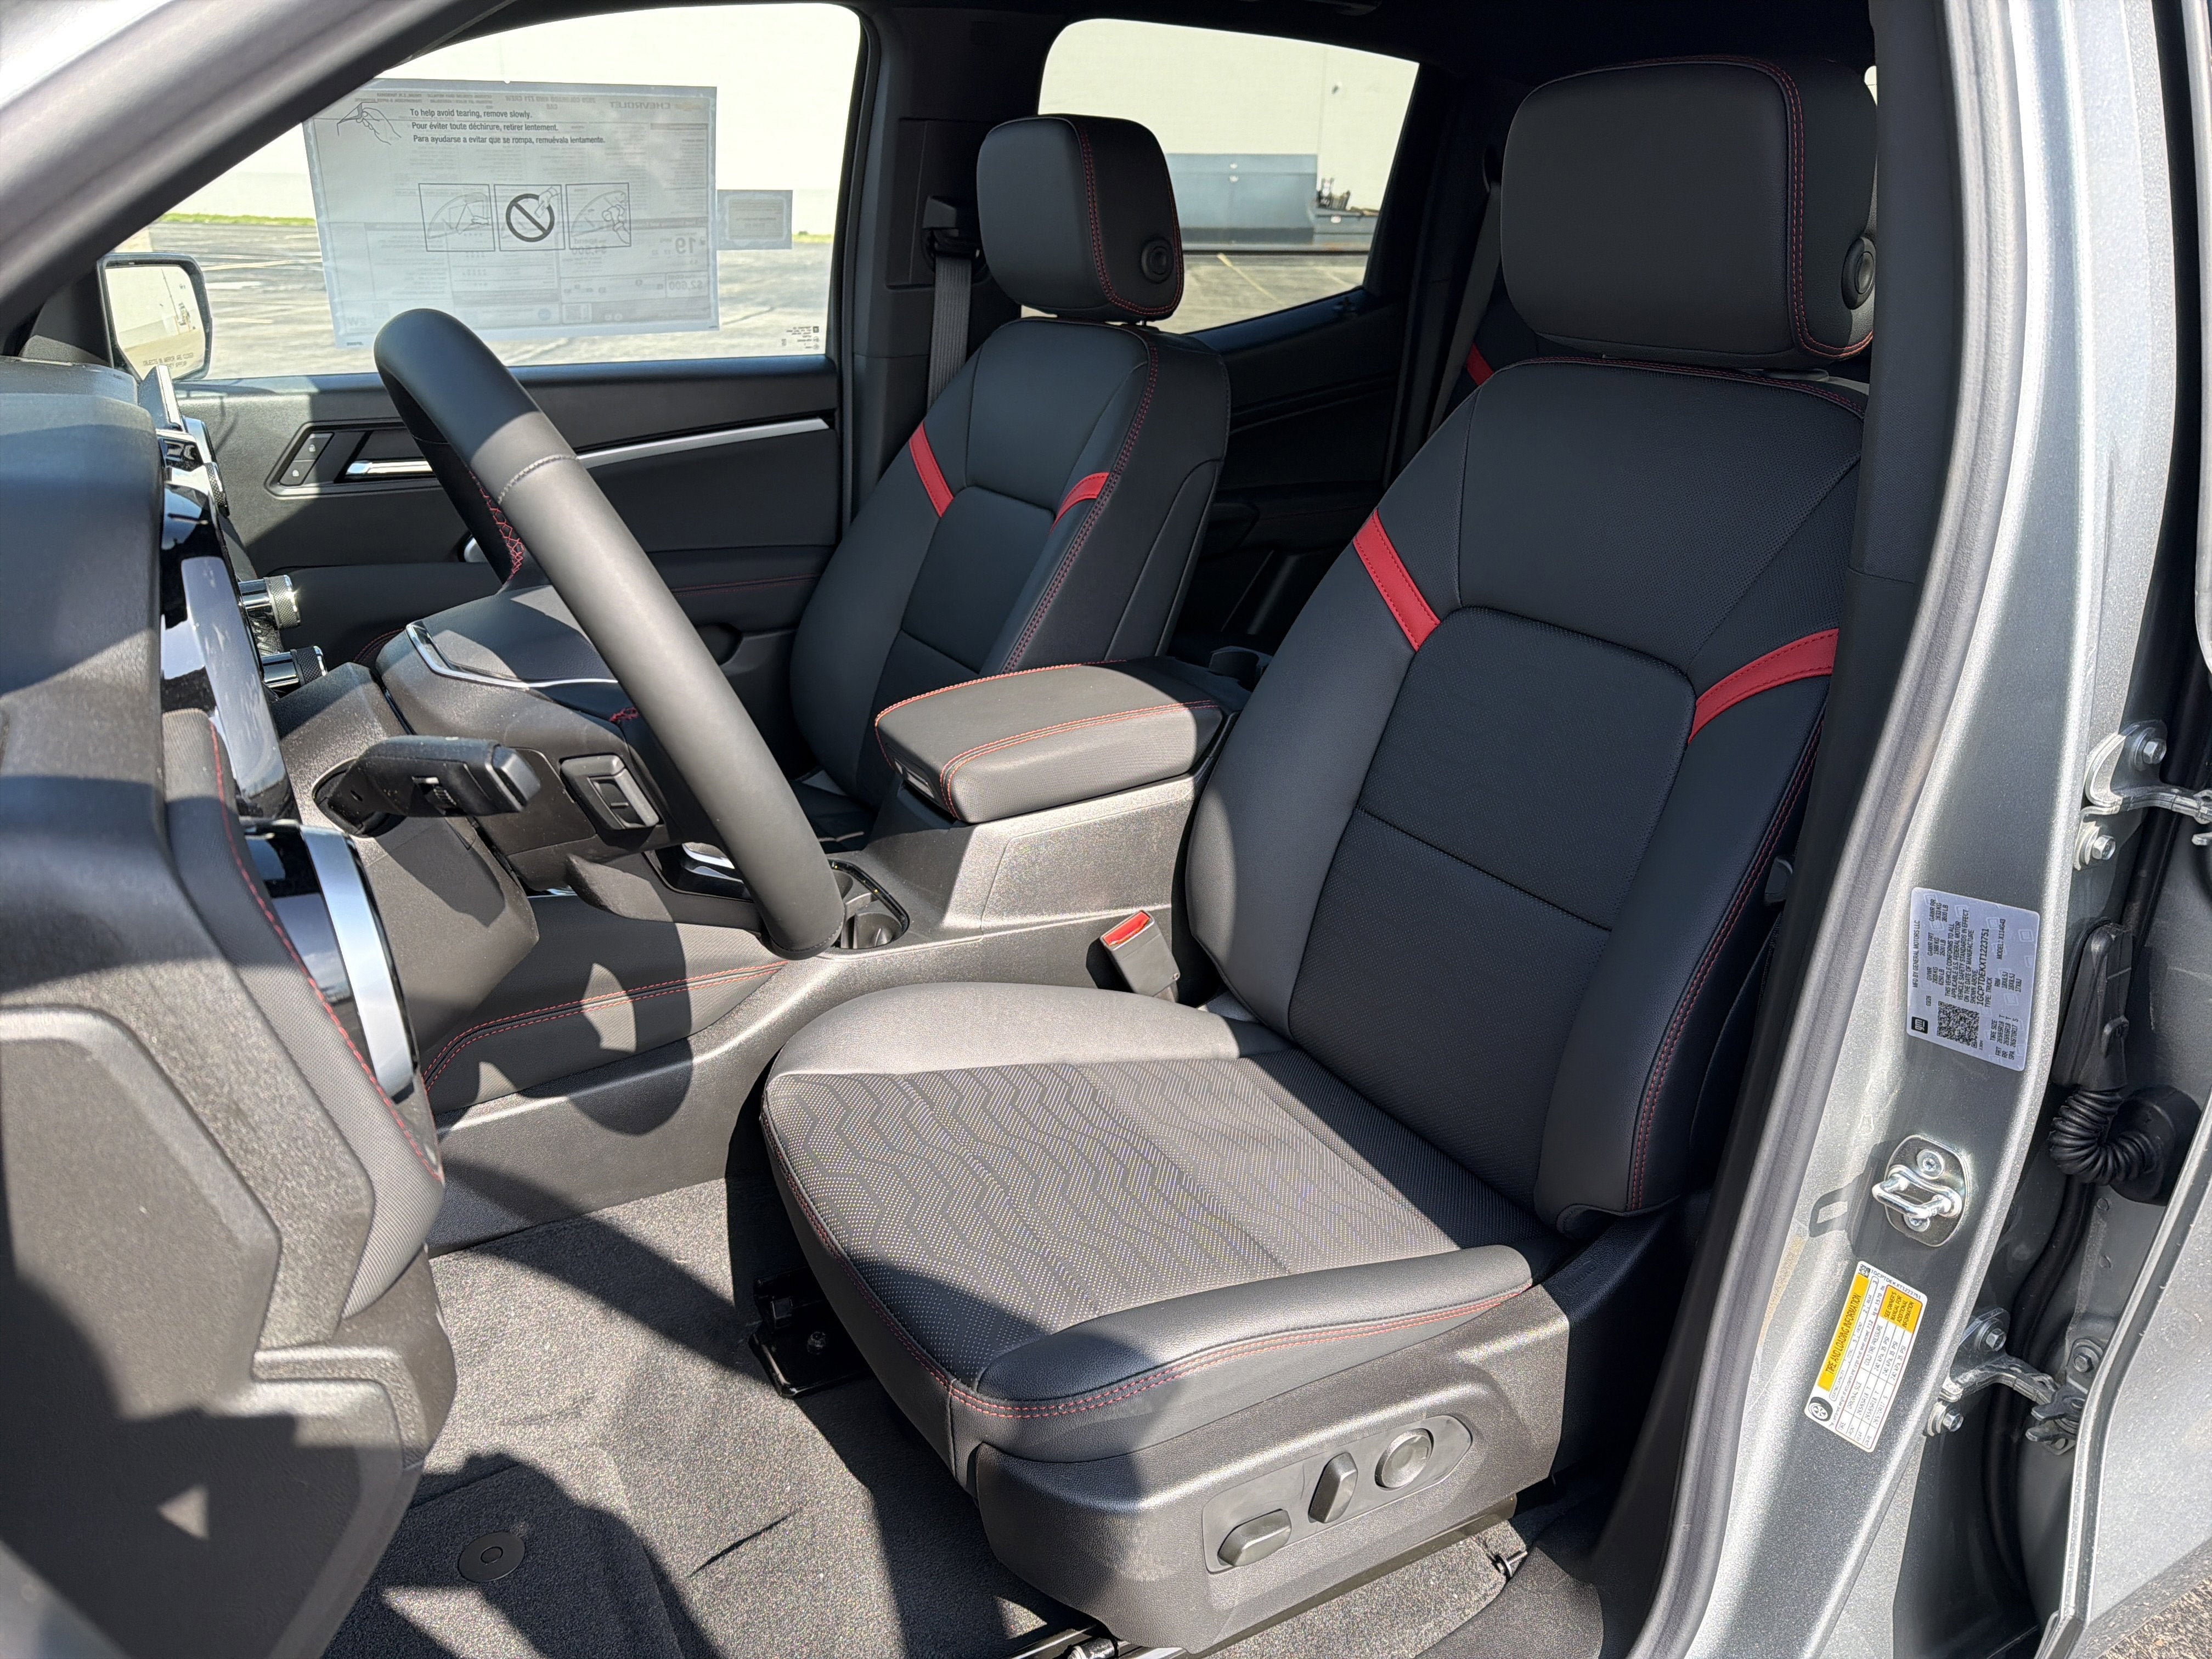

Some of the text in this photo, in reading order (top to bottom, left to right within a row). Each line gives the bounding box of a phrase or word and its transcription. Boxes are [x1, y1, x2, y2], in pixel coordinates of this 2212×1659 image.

[420, 109, 435, 117] help
[456, 110, 482, 119] tearing,
[510, 110, 532, 119] slowly.
[469, 123, 502, 131] déchirure,
[431, 136, 461, 144] ayudarse
[1966, 929, 1974, 964] MANUFACTURE
[1976, 929, 1989, 1005] 1GCPTDEKXT1223751
[1963, 994, 1970, 1002] ON
[1914, 1017, 1925, 1032] gm
[2001, 1050, 2008, 1058] RR
[1890, 1304, 1899, 1321] MANUAL
[1897, 1300, 1908, 1323] ADDITIONAL
[1901, 1301, 1914, 1328] INFORMATION
[1825, 1293, 1861, 1374] TIRE AND LOADING INFORMATION
